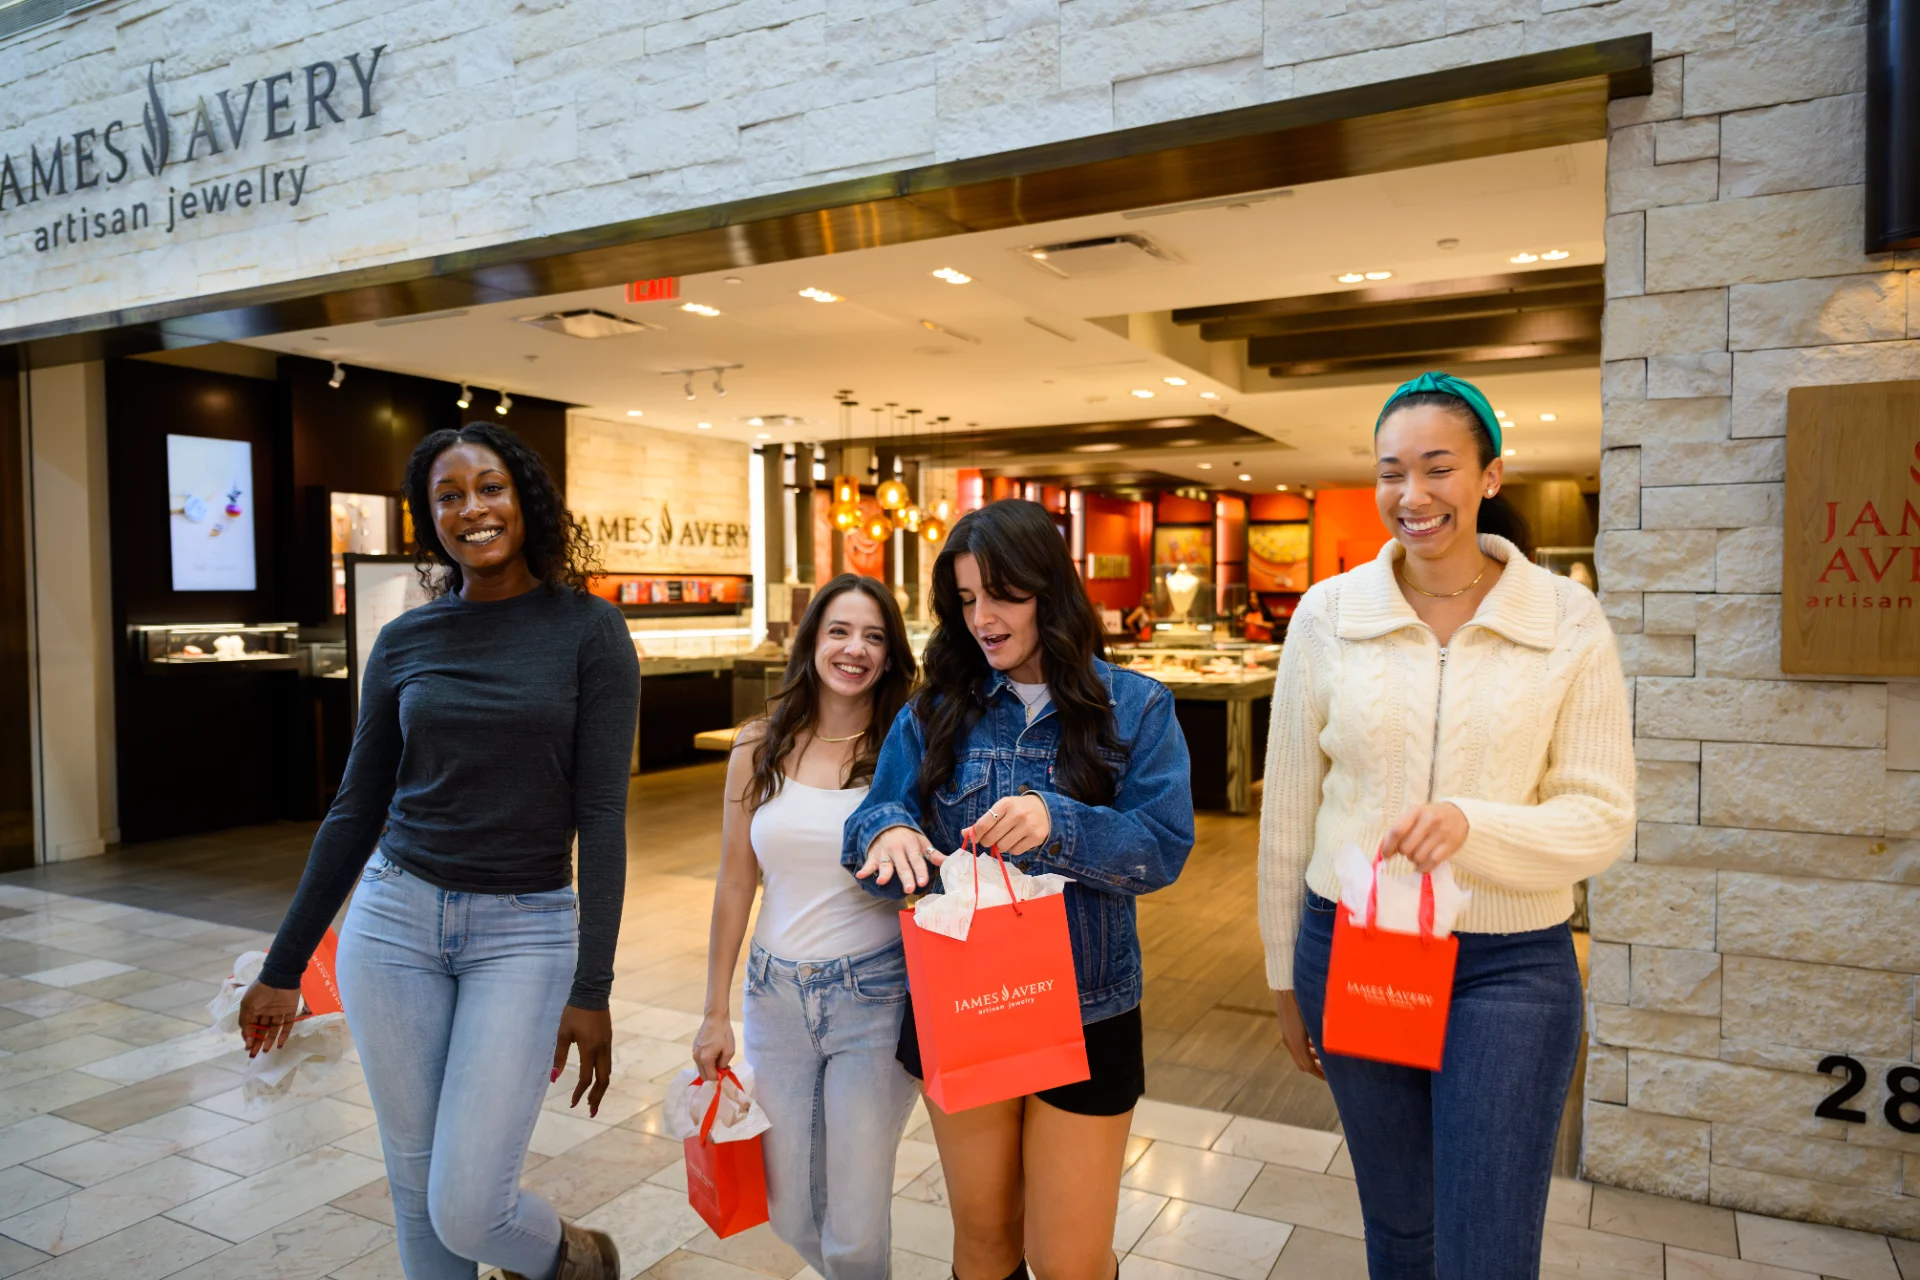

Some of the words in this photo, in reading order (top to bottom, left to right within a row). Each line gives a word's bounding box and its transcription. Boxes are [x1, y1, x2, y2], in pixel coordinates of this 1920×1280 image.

[183, 44, 388, 163] AVERY
[35, 202, 149, 252] artisan
[166, 164, 308, 233] jewelry
[576, 512, 654, 545] AMES
[1805, 592, 1913, 609] artisan
[954, 992, 999, 1014] JAMES
[1011, 979, 1054, 999] AVERY
[978, 1004, 1005, 1015] artisan
[1008, 996, 1035, 1010] jewelry
[1814, 1055, 1920, 1134] 28
